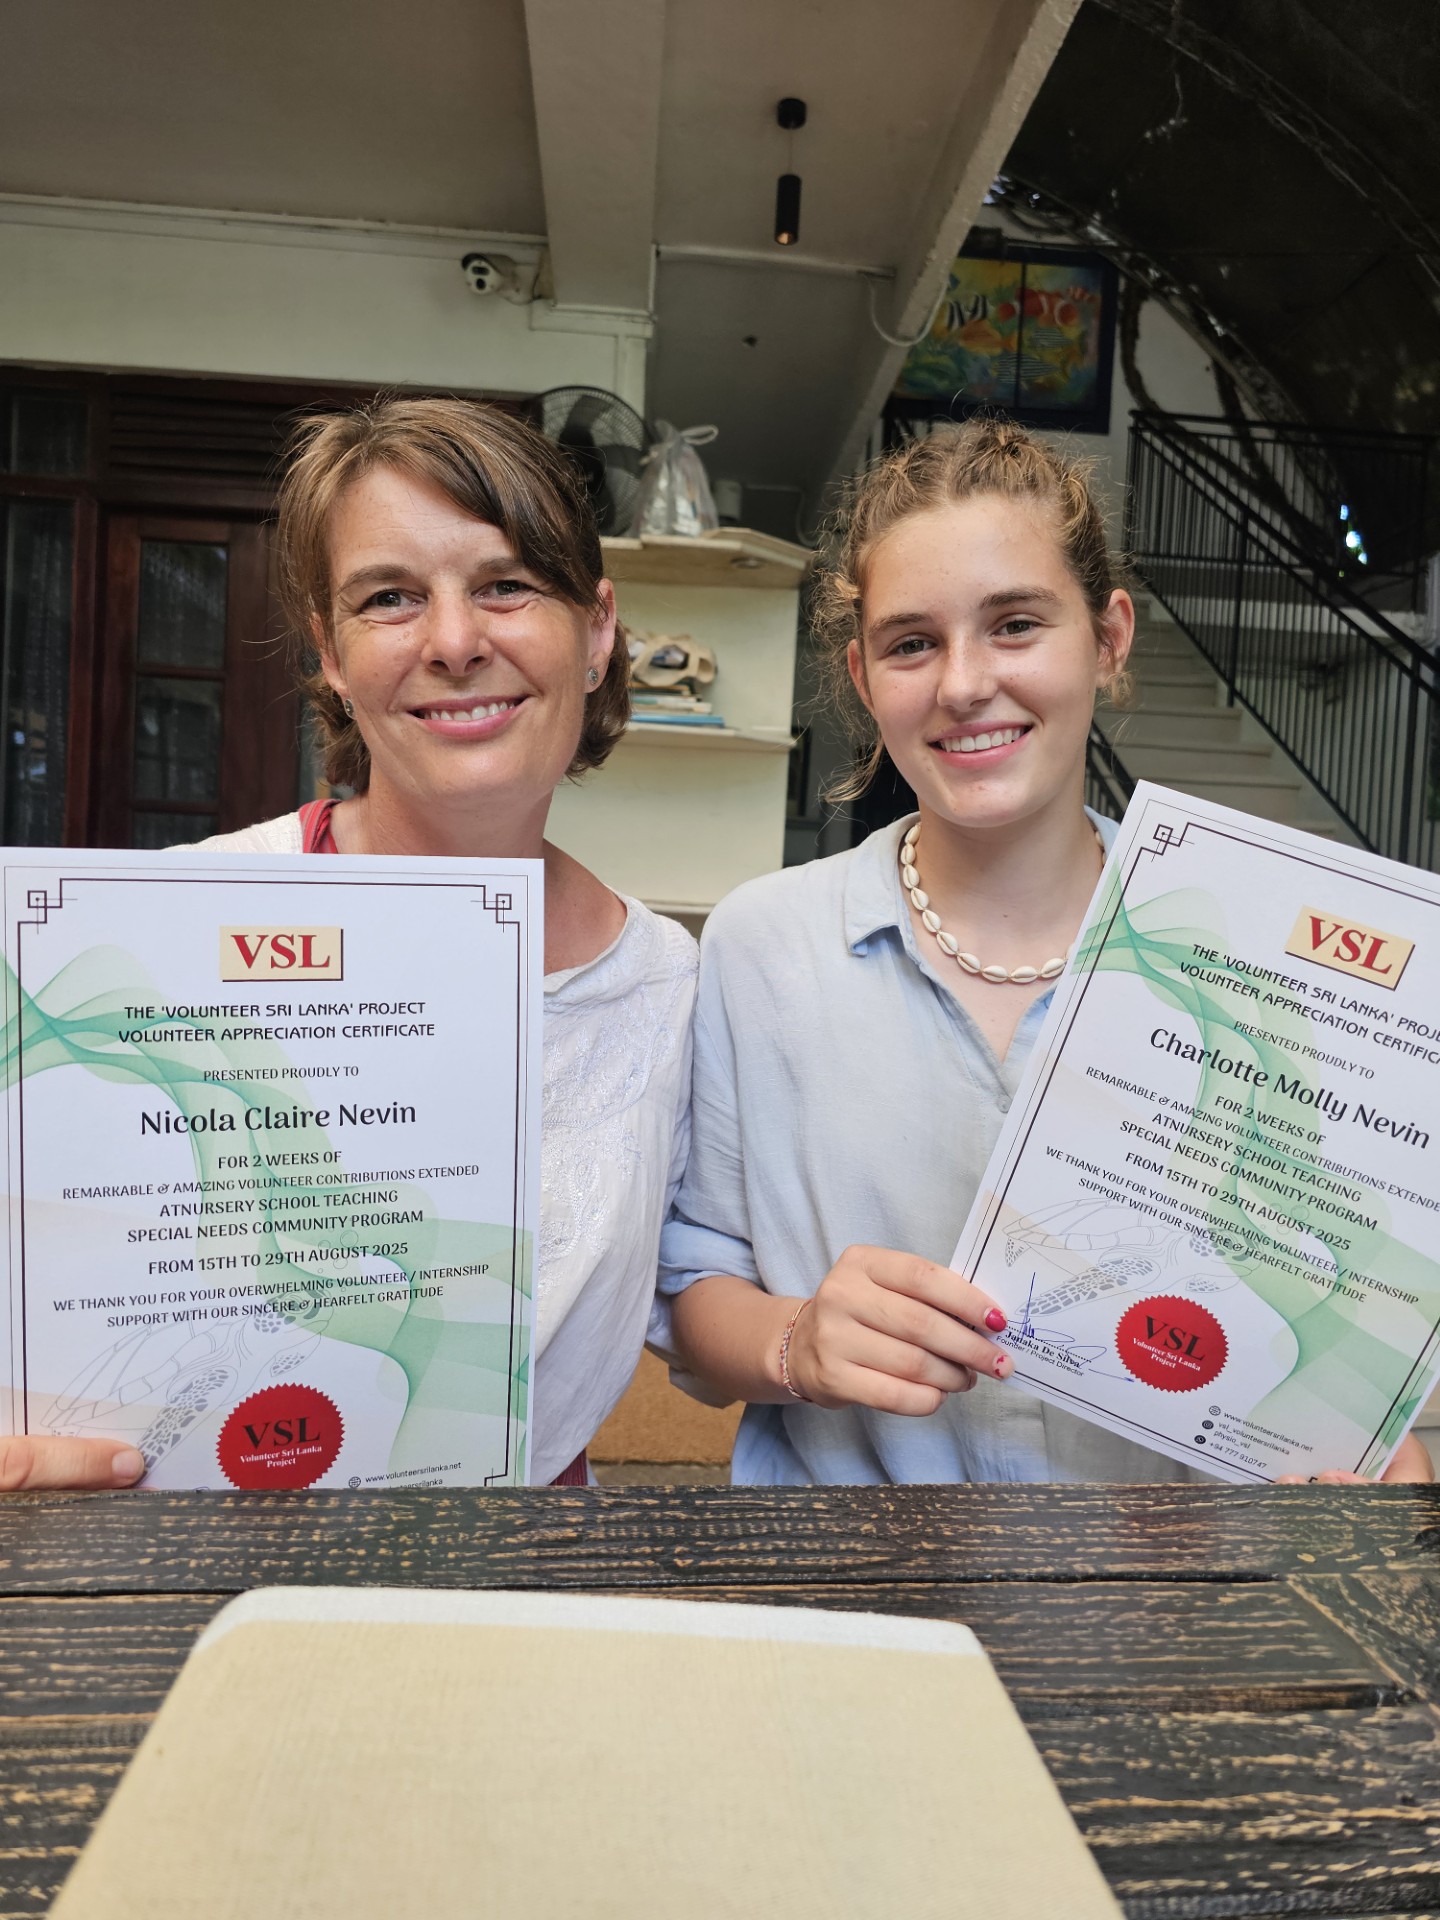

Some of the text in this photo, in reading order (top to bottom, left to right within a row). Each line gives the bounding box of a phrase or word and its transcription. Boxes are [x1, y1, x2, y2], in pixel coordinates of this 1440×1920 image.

[231, 933, 331, 970] VSL
[1309, 915, 1393, 975] VSL
[1180, 961, 1260, 1000] VOLUNTEER
[1262, 992, 1369, 1038] APPRECIATION
[1192, 943, 1219, 963] THE
[1223, 954, 1308, 994] 'VOLUNTEER
[1310, 986, 1337, 1004] SRI
[1339, 996, 1394, 1023] LANKA'
[124, 1001, 426, 1019] THE 'VOLUNTEER SRI LANKA' PROJECT
[118, 1023, 435, 1043] VOLUNTEER APPRECIATION CERTIFICATE
[1233, 1020, 1375, 1079] PRESENTED PROUDLY TO
[203, 1066, 359, 1081] PRESENTED PROUDLY TO
[1150, 1028, 1429, 1149] Charlotte Molly Nevin
[141, 1101, 416, 1135] Nicola Claire Nevin
[1085, 1066, 1158, 1102] REMARKABLE
[1169, 1100, 1223, 1127] AMAZING
[1225, 1120, 1291, 1154] VOLUNTEER
[1292, 1147, 1386, 1190] CONTRIBUTIONS
[1214, 1095, 1326, 1145] FOR 2 WEEKS OF
[218, 1150, 342, 1169] FOR 2 WEEKS OF
[1119, 1120, 1378, 1231] SPECIAL NEEDS COMMUNITY PROGRAM
[1151, 1112, 1362, 1202] ATNURSERY SCHOOL TEACHING
[62, 1183, 154, 1199] REMARKABLE
[173, 1180, 235, 1194] AMAZING
[237, 1175, 313, 1190] VOLUNTEER
[316, 1169, 415, 1185] CONTRIBUTIONS
[418, 1164, 479, 1179] EXTENDED
[159, 1189, 398, 1217] ATNURSERY SCHOOL TEACHING
[1125, 1152, 1351, 1250] FROM 15TH TO 29TH AUGUST 2025
[127, 1210, 423, 1242] SPECIAL NEEDS COMMUNITY PROGRAM
[1046, 1145, 1064, 1160] WE
[1065, 1153, 1101, 1176] THANK
[1102, 1169, 1124, 1185] YOU
[1125, 1179, 1147, 1196] FOR
[1149, 1188, 1178, 1209] YOUR
[1179, 1203, 1271, 1246] OVERWHELMING
[1273, 1239, 1339, 1274] VOLUNTEER
[1348, 1271, 1419, 1304] INTERNSHIP
[1078, 1177, 1128, 1204] SUPPORT
[1129, 1198, 1158, 1217] WITH
[1158, 1211, 1182, 1228] OUR
[1183, 1221, 1231, 1248] SINCERE
[1244, 1246, 1302, 1276] HEARFELT
[1302, 1270, 1367, 1302] GRATITUDE
[148, 1242, 408, 1275] FROM 15TH TO 29TH AUGUST 2025
[53, 1299, 75, 1311] WE
[78, 1296, 125, 1310] THANK
[129, 1293, 157, 1306] YOU
[160, 1291, 186, 1303] FOR
[189, 1287, 226, 1301] YOUR
[228, 1278, 333, 1298] OVERWHELMING
[336, 1271, 407, 1288] VOLUNTEER
[419, 1264, 489, 1280] INTERNSHIP
[107, 1312, 169, 1327] SUPPORT
[171, 1308, 207, 1322] WITH
[210, 1305, 238, 1318] OUR
[241, 1300, 295, 1316] SINCERE
[313, 1292, 375, 1310] HEARFELT
[377, 1285, 443, 1302] GRATITUDE
[1133, 1337, 1201, 1371] Volunteer Sri Lanka
[1146, 1315, 1205, 1361] VSL
[1151, 1353, 1176, 1368] Project
[242, 1416, 321, 1450] VSL
[1224, 1412, 1314, 1452] www.volunteersrilanka.net
[240, 1445, 322, 1463] Volunteer Sri Lanka
[266, 1457, 296, 1468] Project
[365, 1462, 461, 1483] www.volunteersrilanka.net
